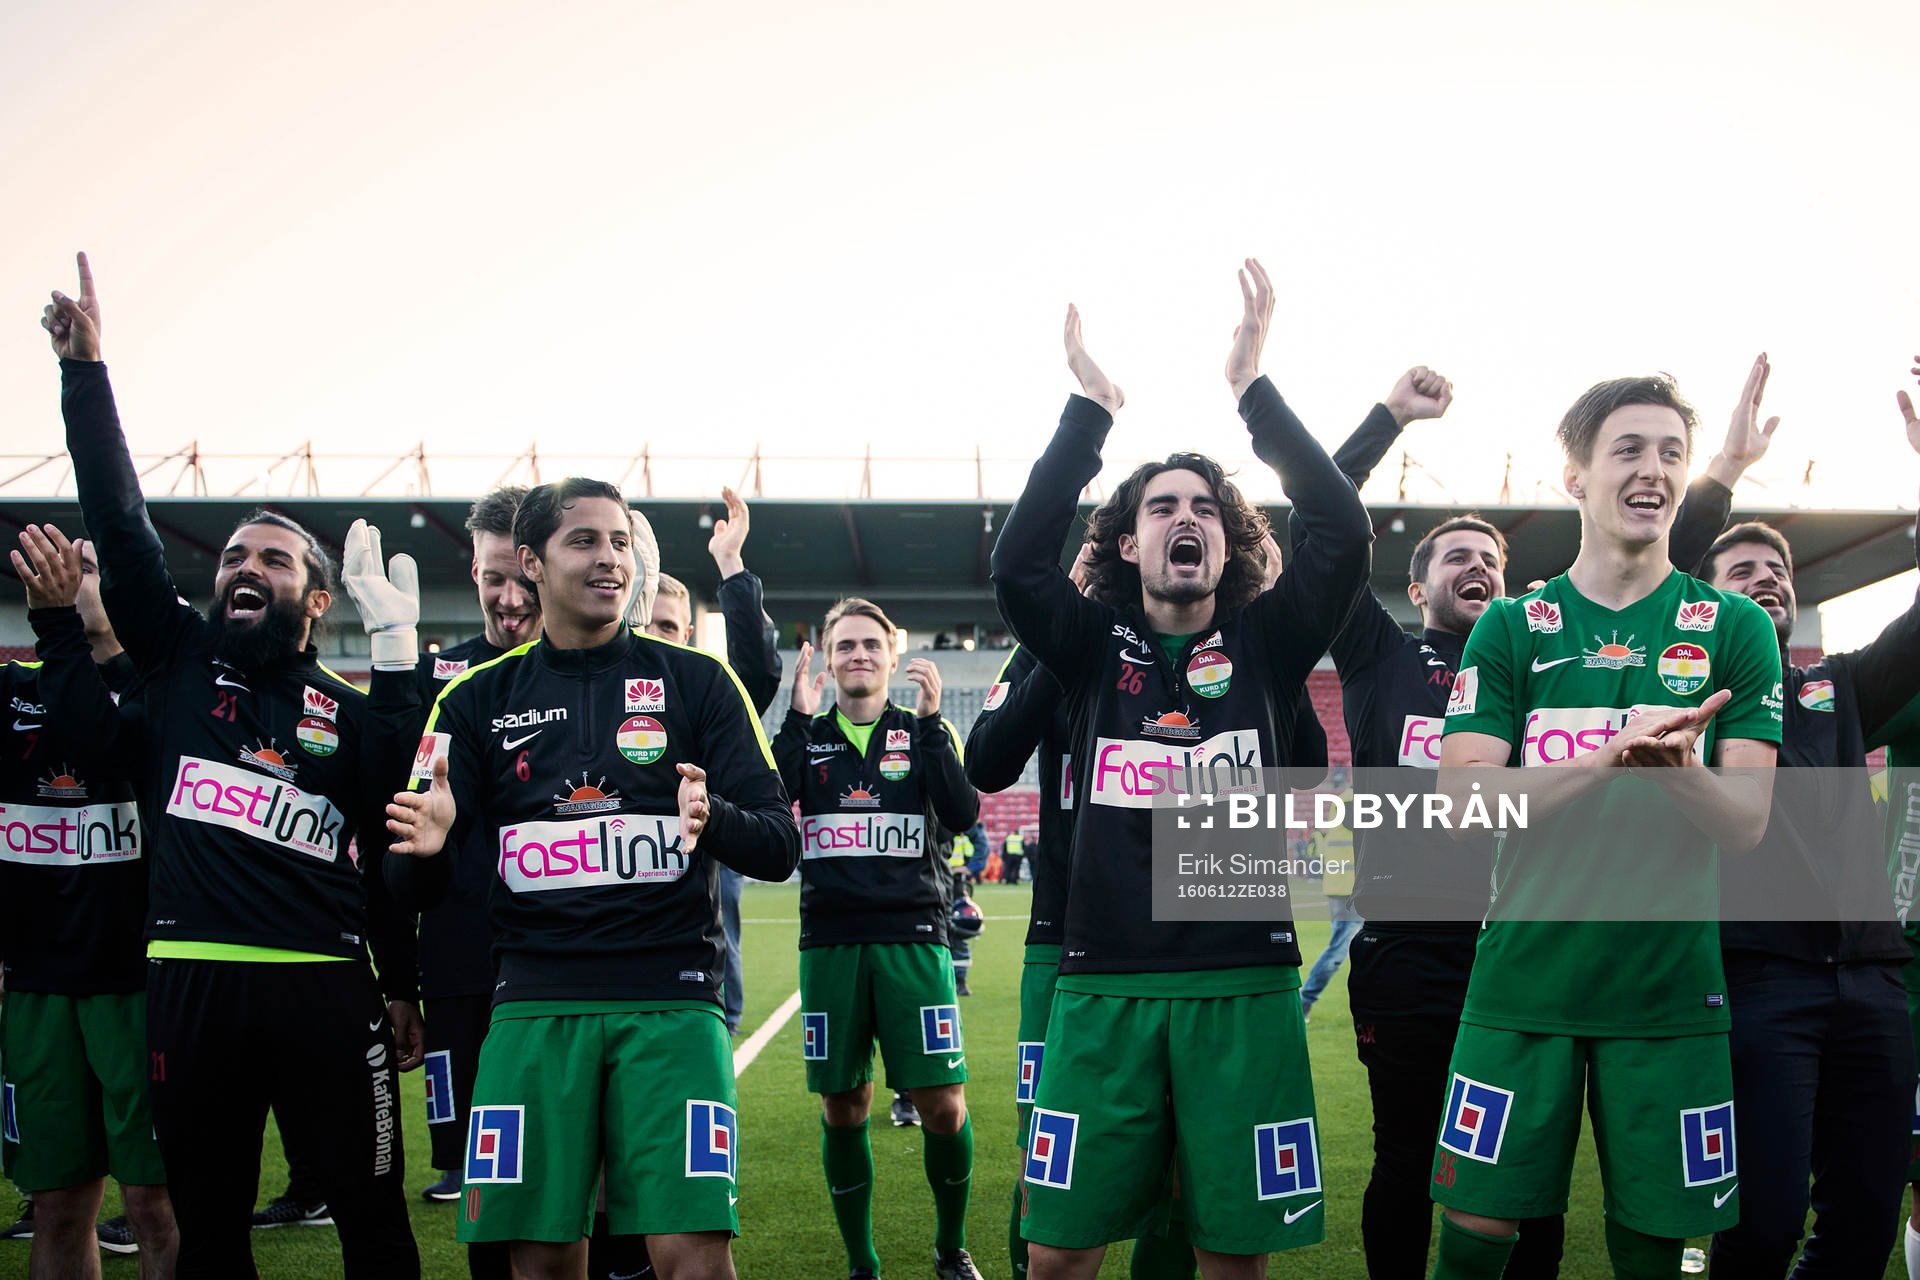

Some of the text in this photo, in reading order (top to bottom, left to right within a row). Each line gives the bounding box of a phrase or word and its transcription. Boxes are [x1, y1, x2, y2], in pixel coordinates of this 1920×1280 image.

[1198, 655, 1216, 664] DAL
[1676, 649, 1694, 657] DAL
[1116, 662, 1147, 696] 26
[1200, 681, 1229, 693] KURD FF
[1667, 678, 1700, 688] KURD FF
[211, 690, 238, 723] 21
[626, 704, 665, 712] HUAWEI
[311, 719, 326, 729] DAL
[632, 720, 651, 728] DAL
[515, 750, 531, 782] 6
[626, 750, 648, 758] KURD
[1095, 735, 1256, 796] fastlink
[819, 764, 829, 785] 5
[174, 761, 340, 850] fastlink
[500, 819, 685, 881] fastlink
[803, 815, 921, 853] fastlink
[372, 1068, 394, 1177] KaffeBönan
[1433, 1151, 1458, 1189] 26
[464, 1185, 482, 1223] 10
